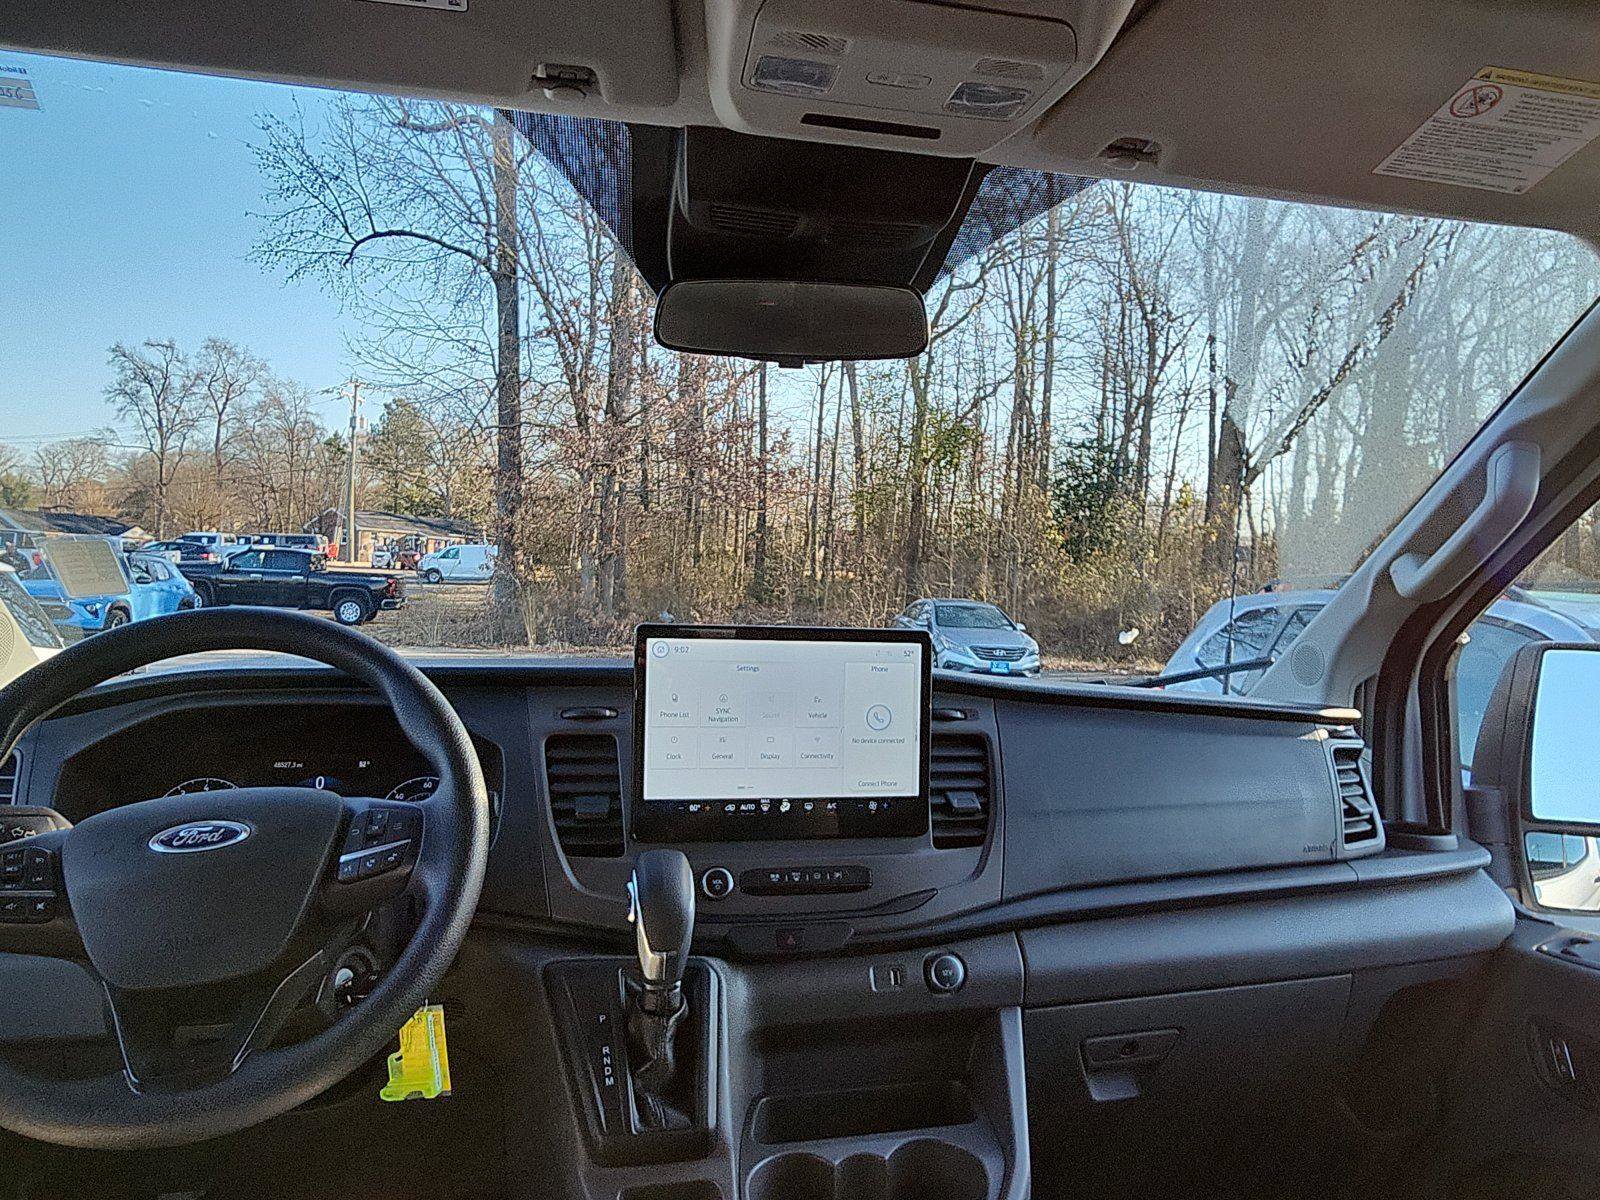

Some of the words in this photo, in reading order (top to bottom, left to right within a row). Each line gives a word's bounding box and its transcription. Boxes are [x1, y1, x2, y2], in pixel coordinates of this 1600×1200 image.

[673, 646, 690, 654] 9:02
[736, 664, 760, 672] Settings
[800, 752, 834, 760] Connectivity
[315, 776, 325, 790] 0
[423, 781, 433, 789] 60
[740, 803, 756, 811] AUTO
[172, 826, 226, 847] Ford
[599, 1014, 606, 1023] P
[602, 1046, 610, 1055] R
[603, 1056, 611, 1065] N
[604, 1066, 612, 1076] D
[605, 1076, 614, 1087] M
